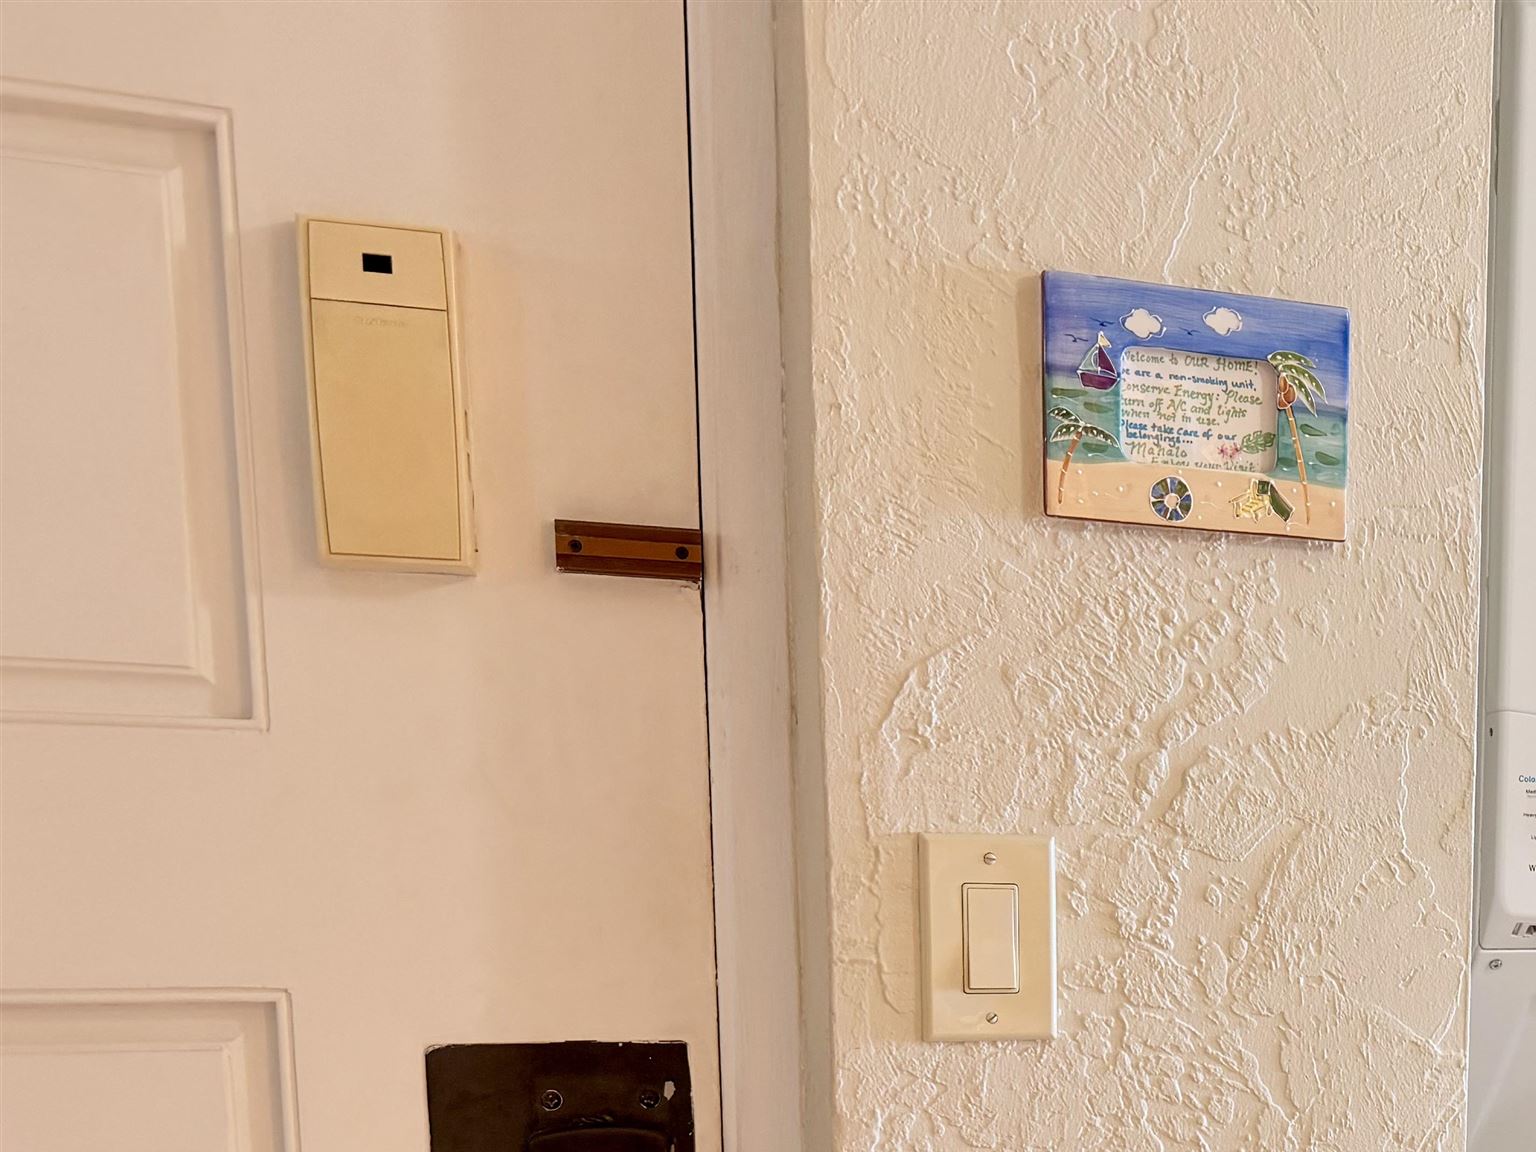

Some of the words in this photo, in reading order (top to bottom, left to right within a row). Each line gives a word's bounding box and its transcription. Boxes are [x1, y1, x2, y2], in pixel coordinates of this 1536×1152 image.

[1169, 352, 1179, 366] to
[1184, 355, 1209, 369] OUR
[1122, 381, 1171, 395] onserve
[1134, 370, 1151, 378] are
[1169, 373, 1228, 393] non-smoking
[1231, 379, 1257, 392] unit.
[1148, 398, 1164, 413] off
[1167, 399, 1187, 412] A/C
[1190, 402, 1211, 415] and
[1157, 411, 1176, 422] not
[1182, 413, 1192, 422] in
[1196, 415, 1220, 426] use.
[1151, 422, 1175, 434] take
[1202, 429, 1213, 440] of
[1125, 442, 1188, 458] Mahalo
